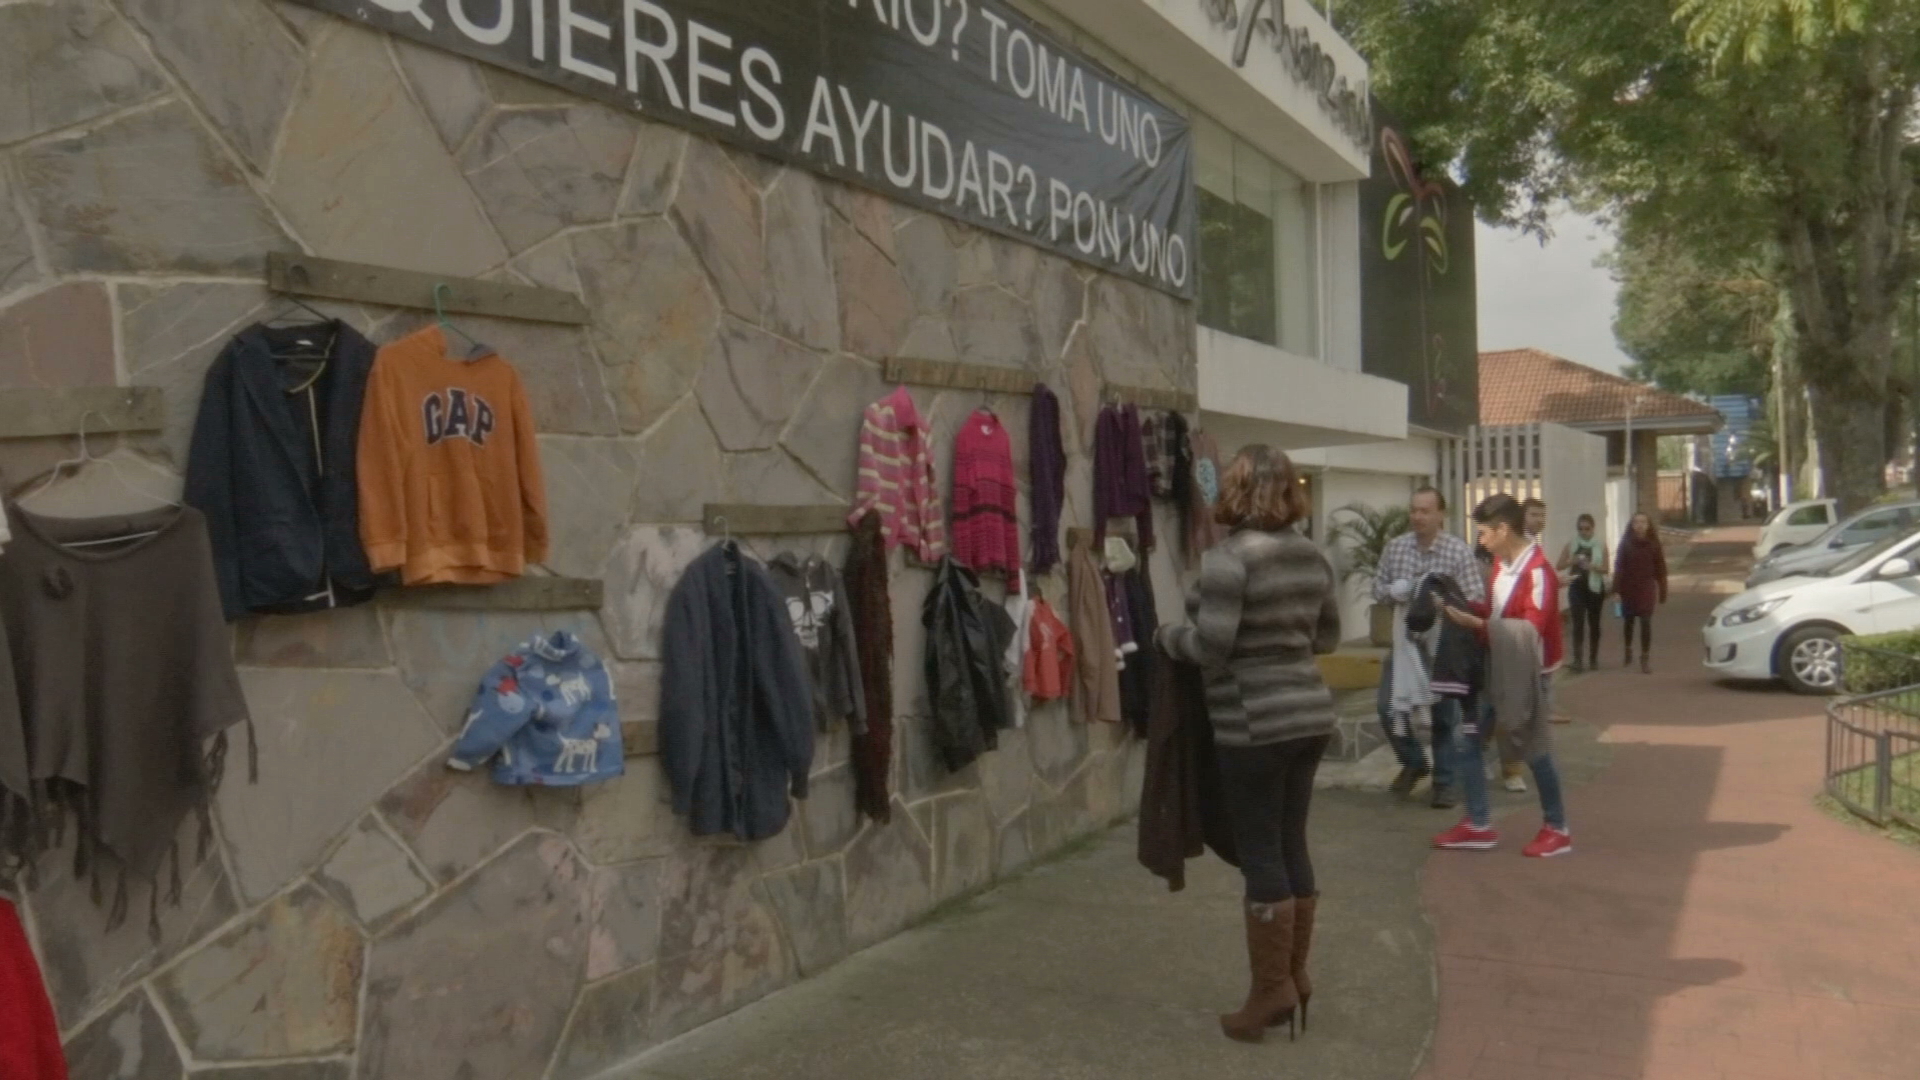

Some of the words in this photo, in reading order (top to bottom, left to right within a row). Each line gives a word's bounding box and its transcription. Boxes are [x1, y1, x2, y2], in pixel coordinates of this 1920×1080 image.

[369, 0, 785, 141] IERES
[801, 75, 1037, 231] AYUDAR?
[1050, 177, 1121, 263] PON
[1129, 213, 1187, 288] UNO
[981, 7, 1091, 132] TOMA
[1098, 81, 1161, 168] UNO
[422, 387, 495, 448] GAP
